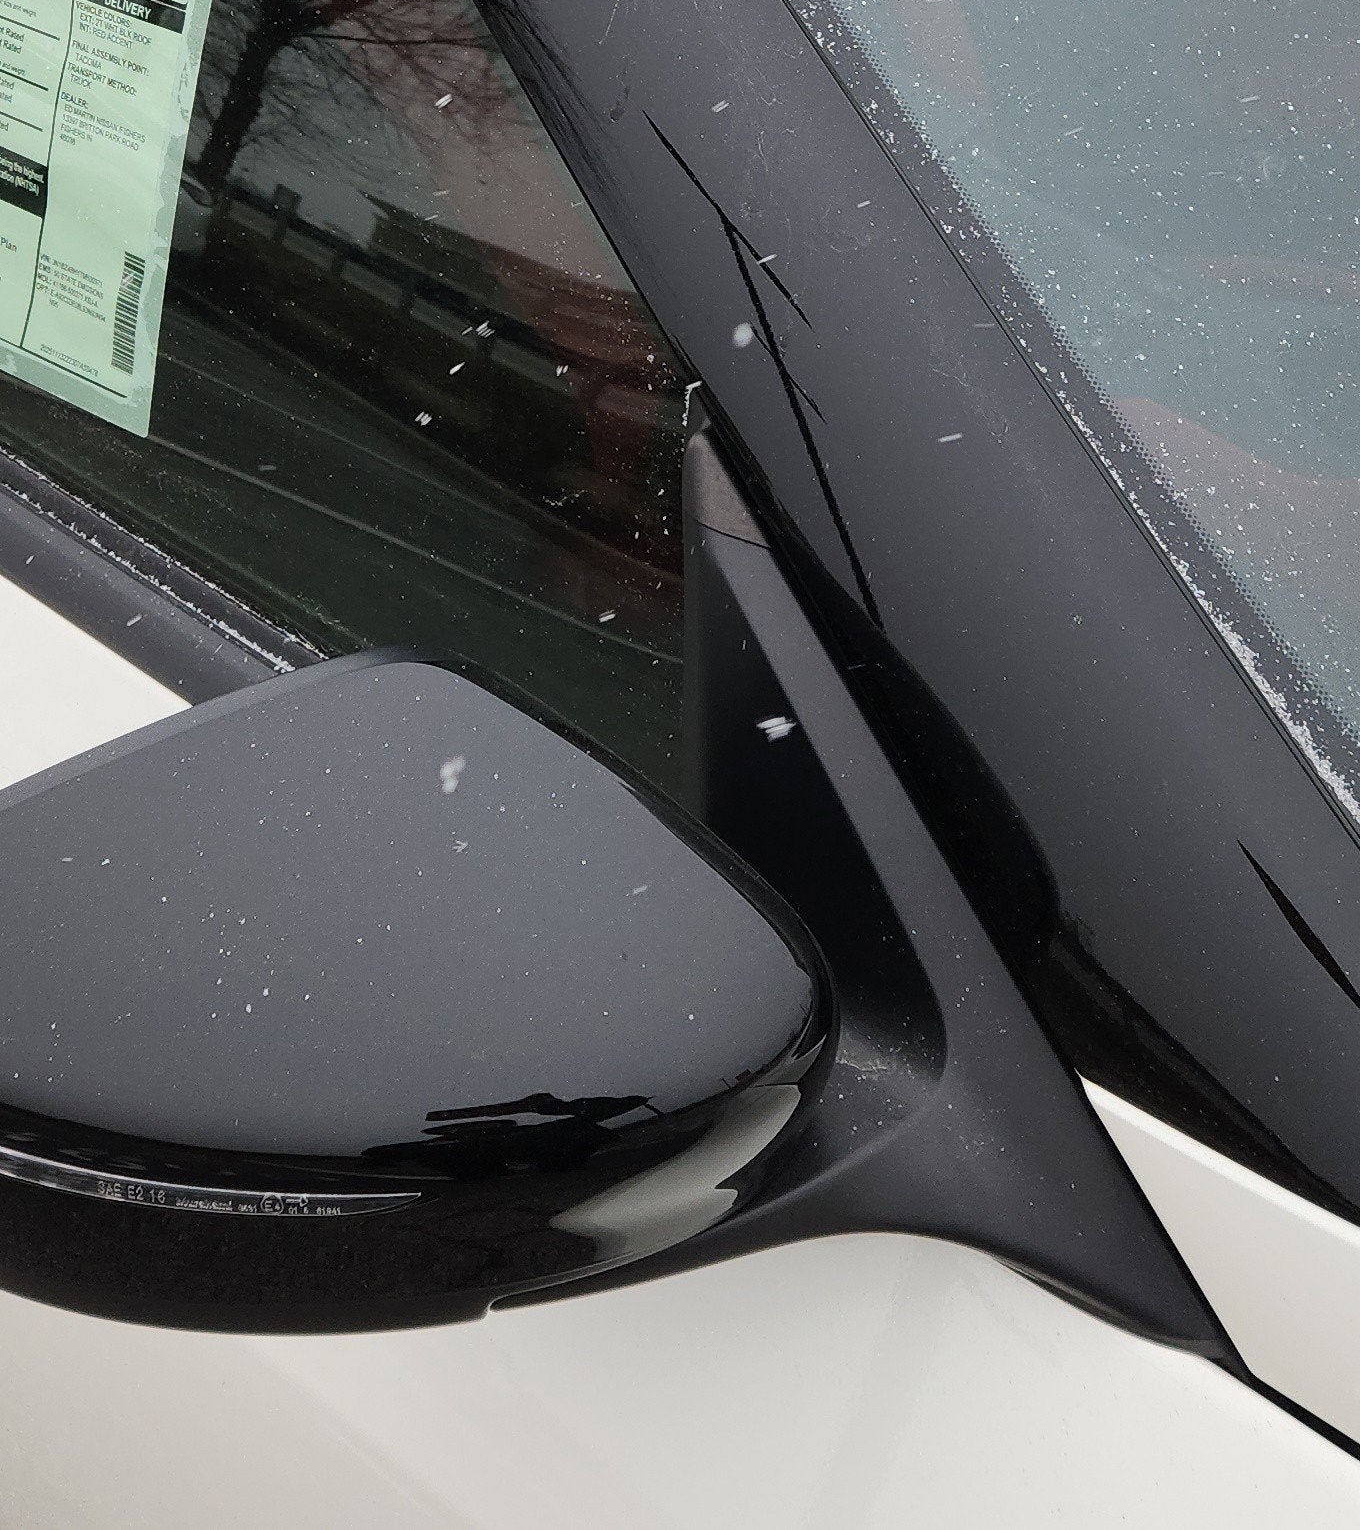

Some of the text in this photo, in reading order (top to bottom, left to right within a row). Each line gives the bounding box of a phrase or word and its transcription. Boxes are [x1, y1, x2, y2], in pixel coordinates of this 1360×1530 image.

[76, 0, 132, 28] VEHICLE COLORS:
[6, 28, 24, 42] Rated
[3, 40, 22, 54] Rated
[72, 40, 150, 76] FINAL ASSEMBLY POINT:
[68, 62, 138, 96] TRANSPORT METHOD:
[70, 73, 92, 88] TRUCK
[60, 92, 88, 109] DEALER:
[96, 1181, 122, 1198] SAE
[128, 1186, 144, 1200] E2
